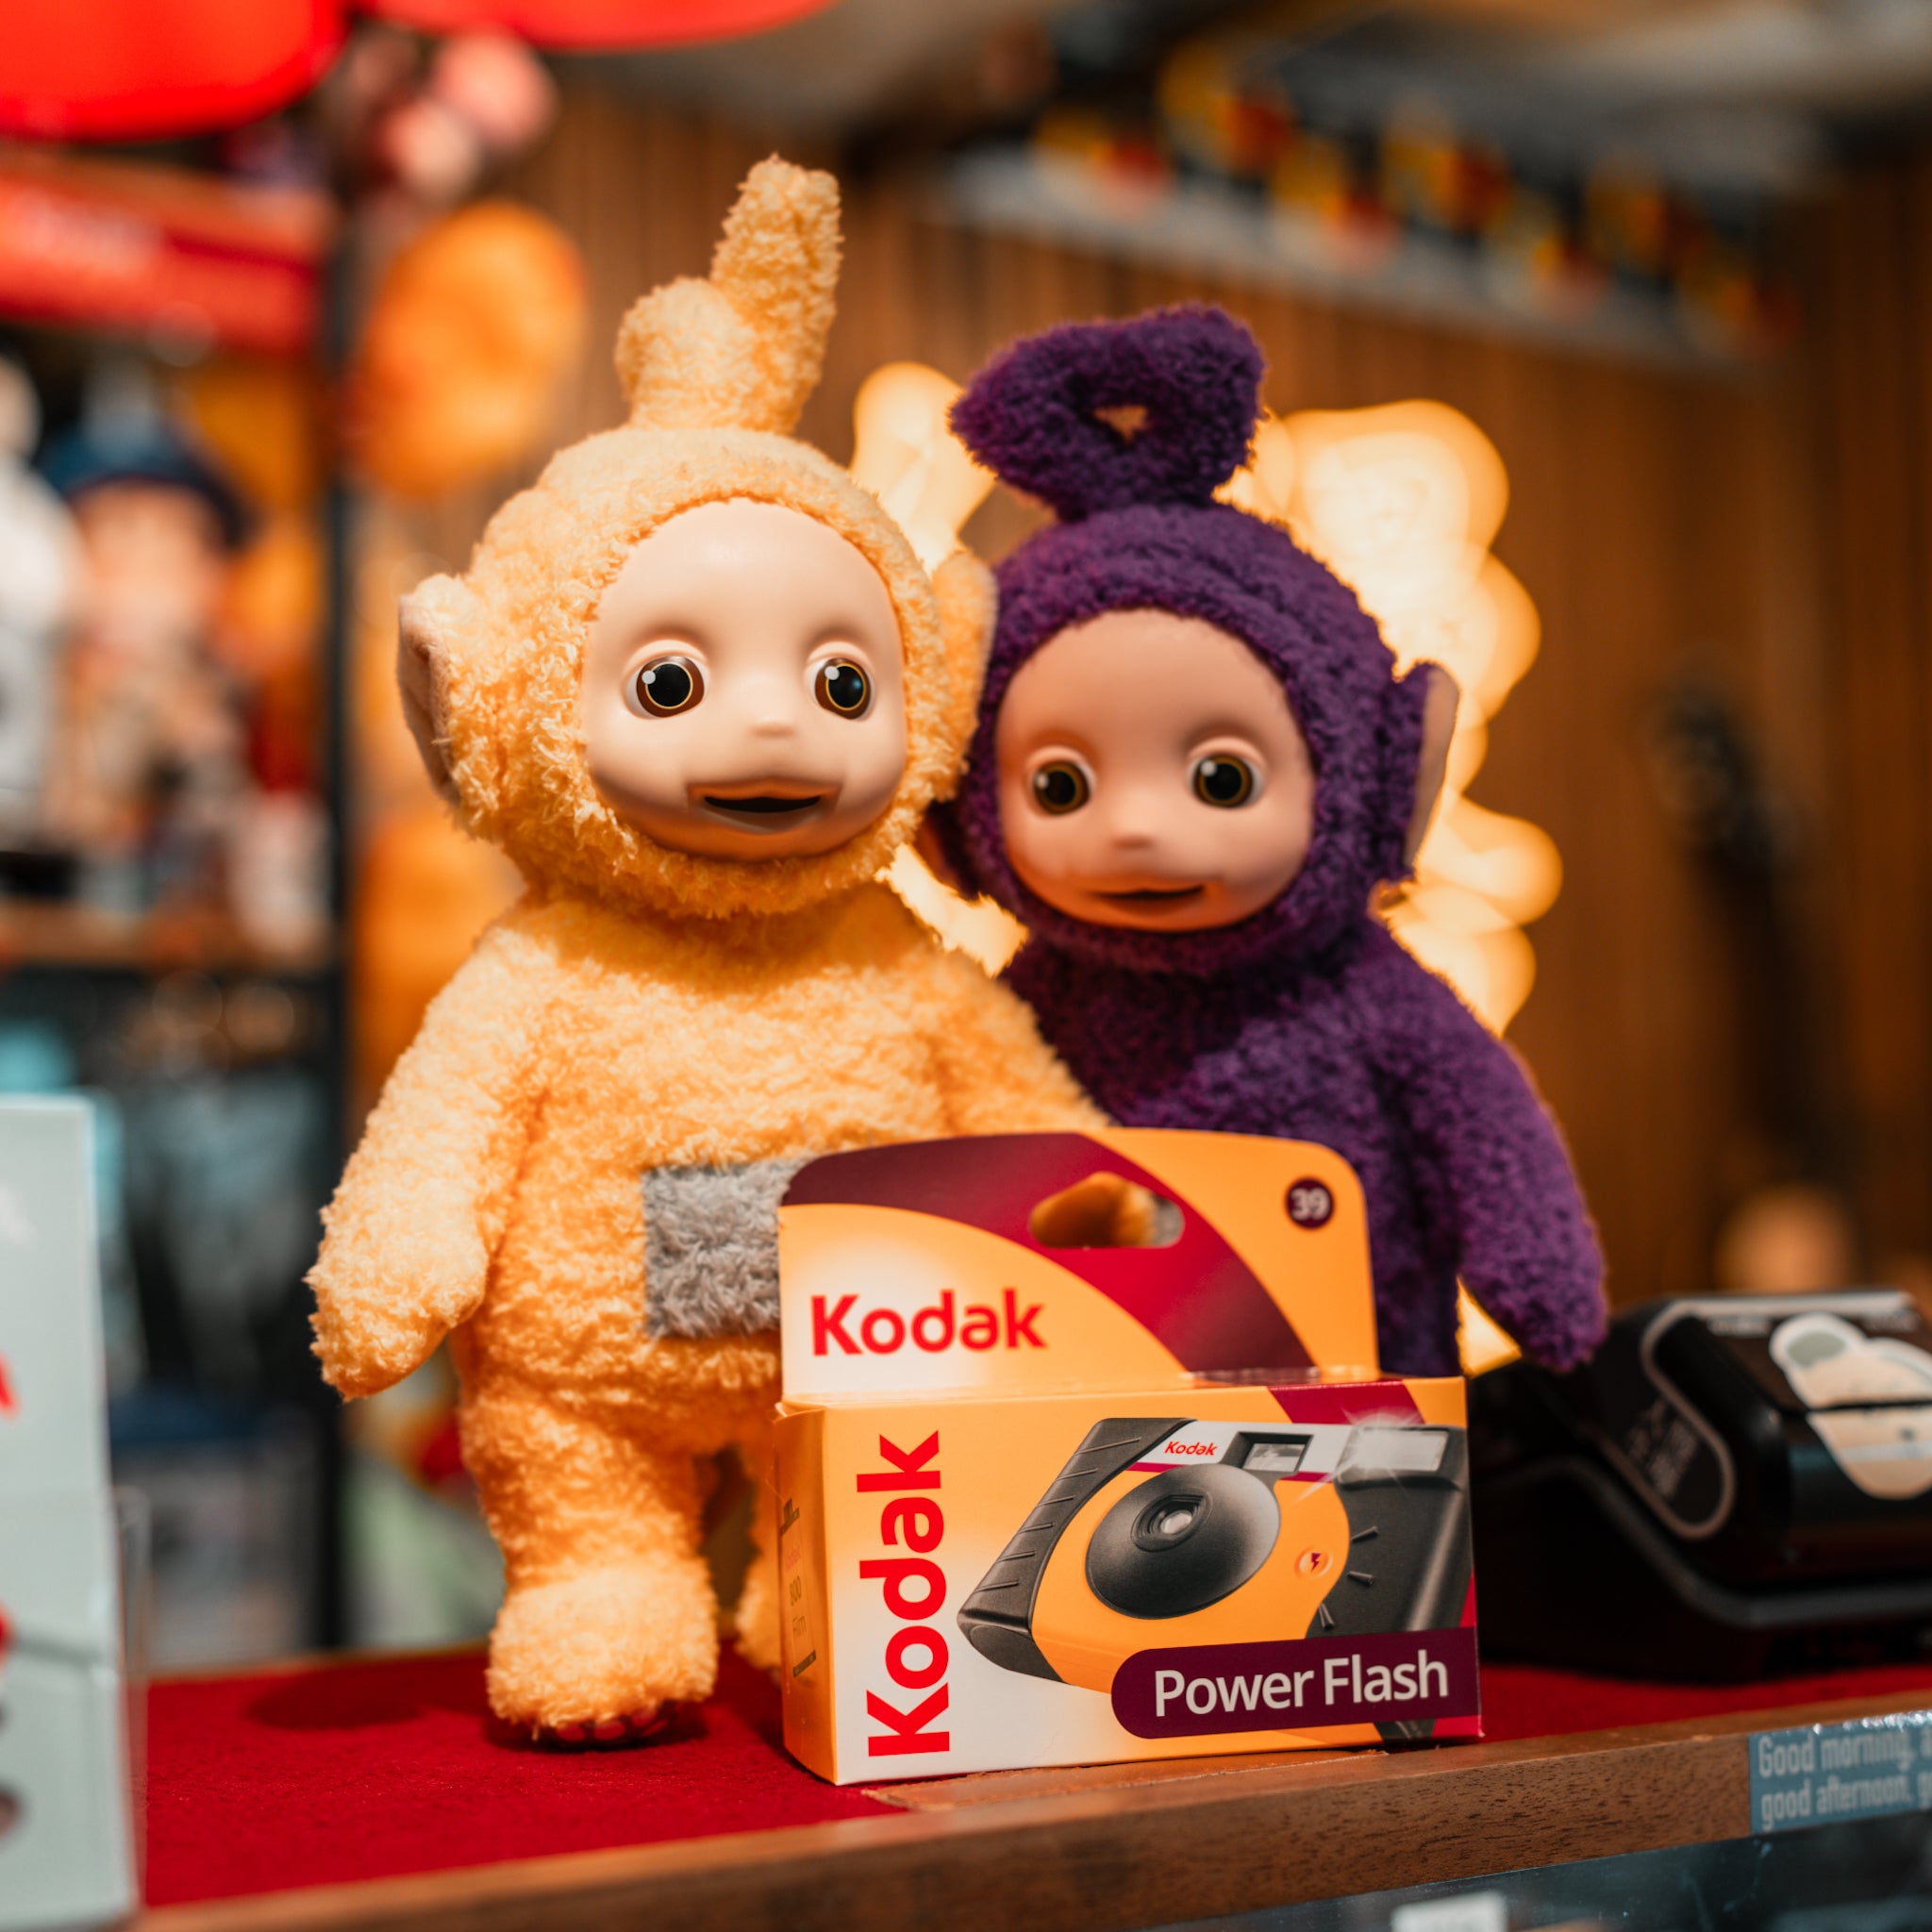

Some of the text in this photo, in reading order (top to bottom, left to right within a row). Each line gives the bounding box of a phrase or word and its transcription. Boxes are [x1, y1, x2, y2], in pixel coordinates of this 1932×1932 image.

[1290, 1188, 1331, 1221] 39
[810, 1287, 1050, 1357] Kodak
[1164, 1441, 1219, 1456] Kodak
[856, 1429, 951, 1757] Kodak
[1154, 1649, 1450, 1717] Power Flash
[1758, 1734, 1816, 1778] Good
[1760, 1778, 1812, 1832] good
